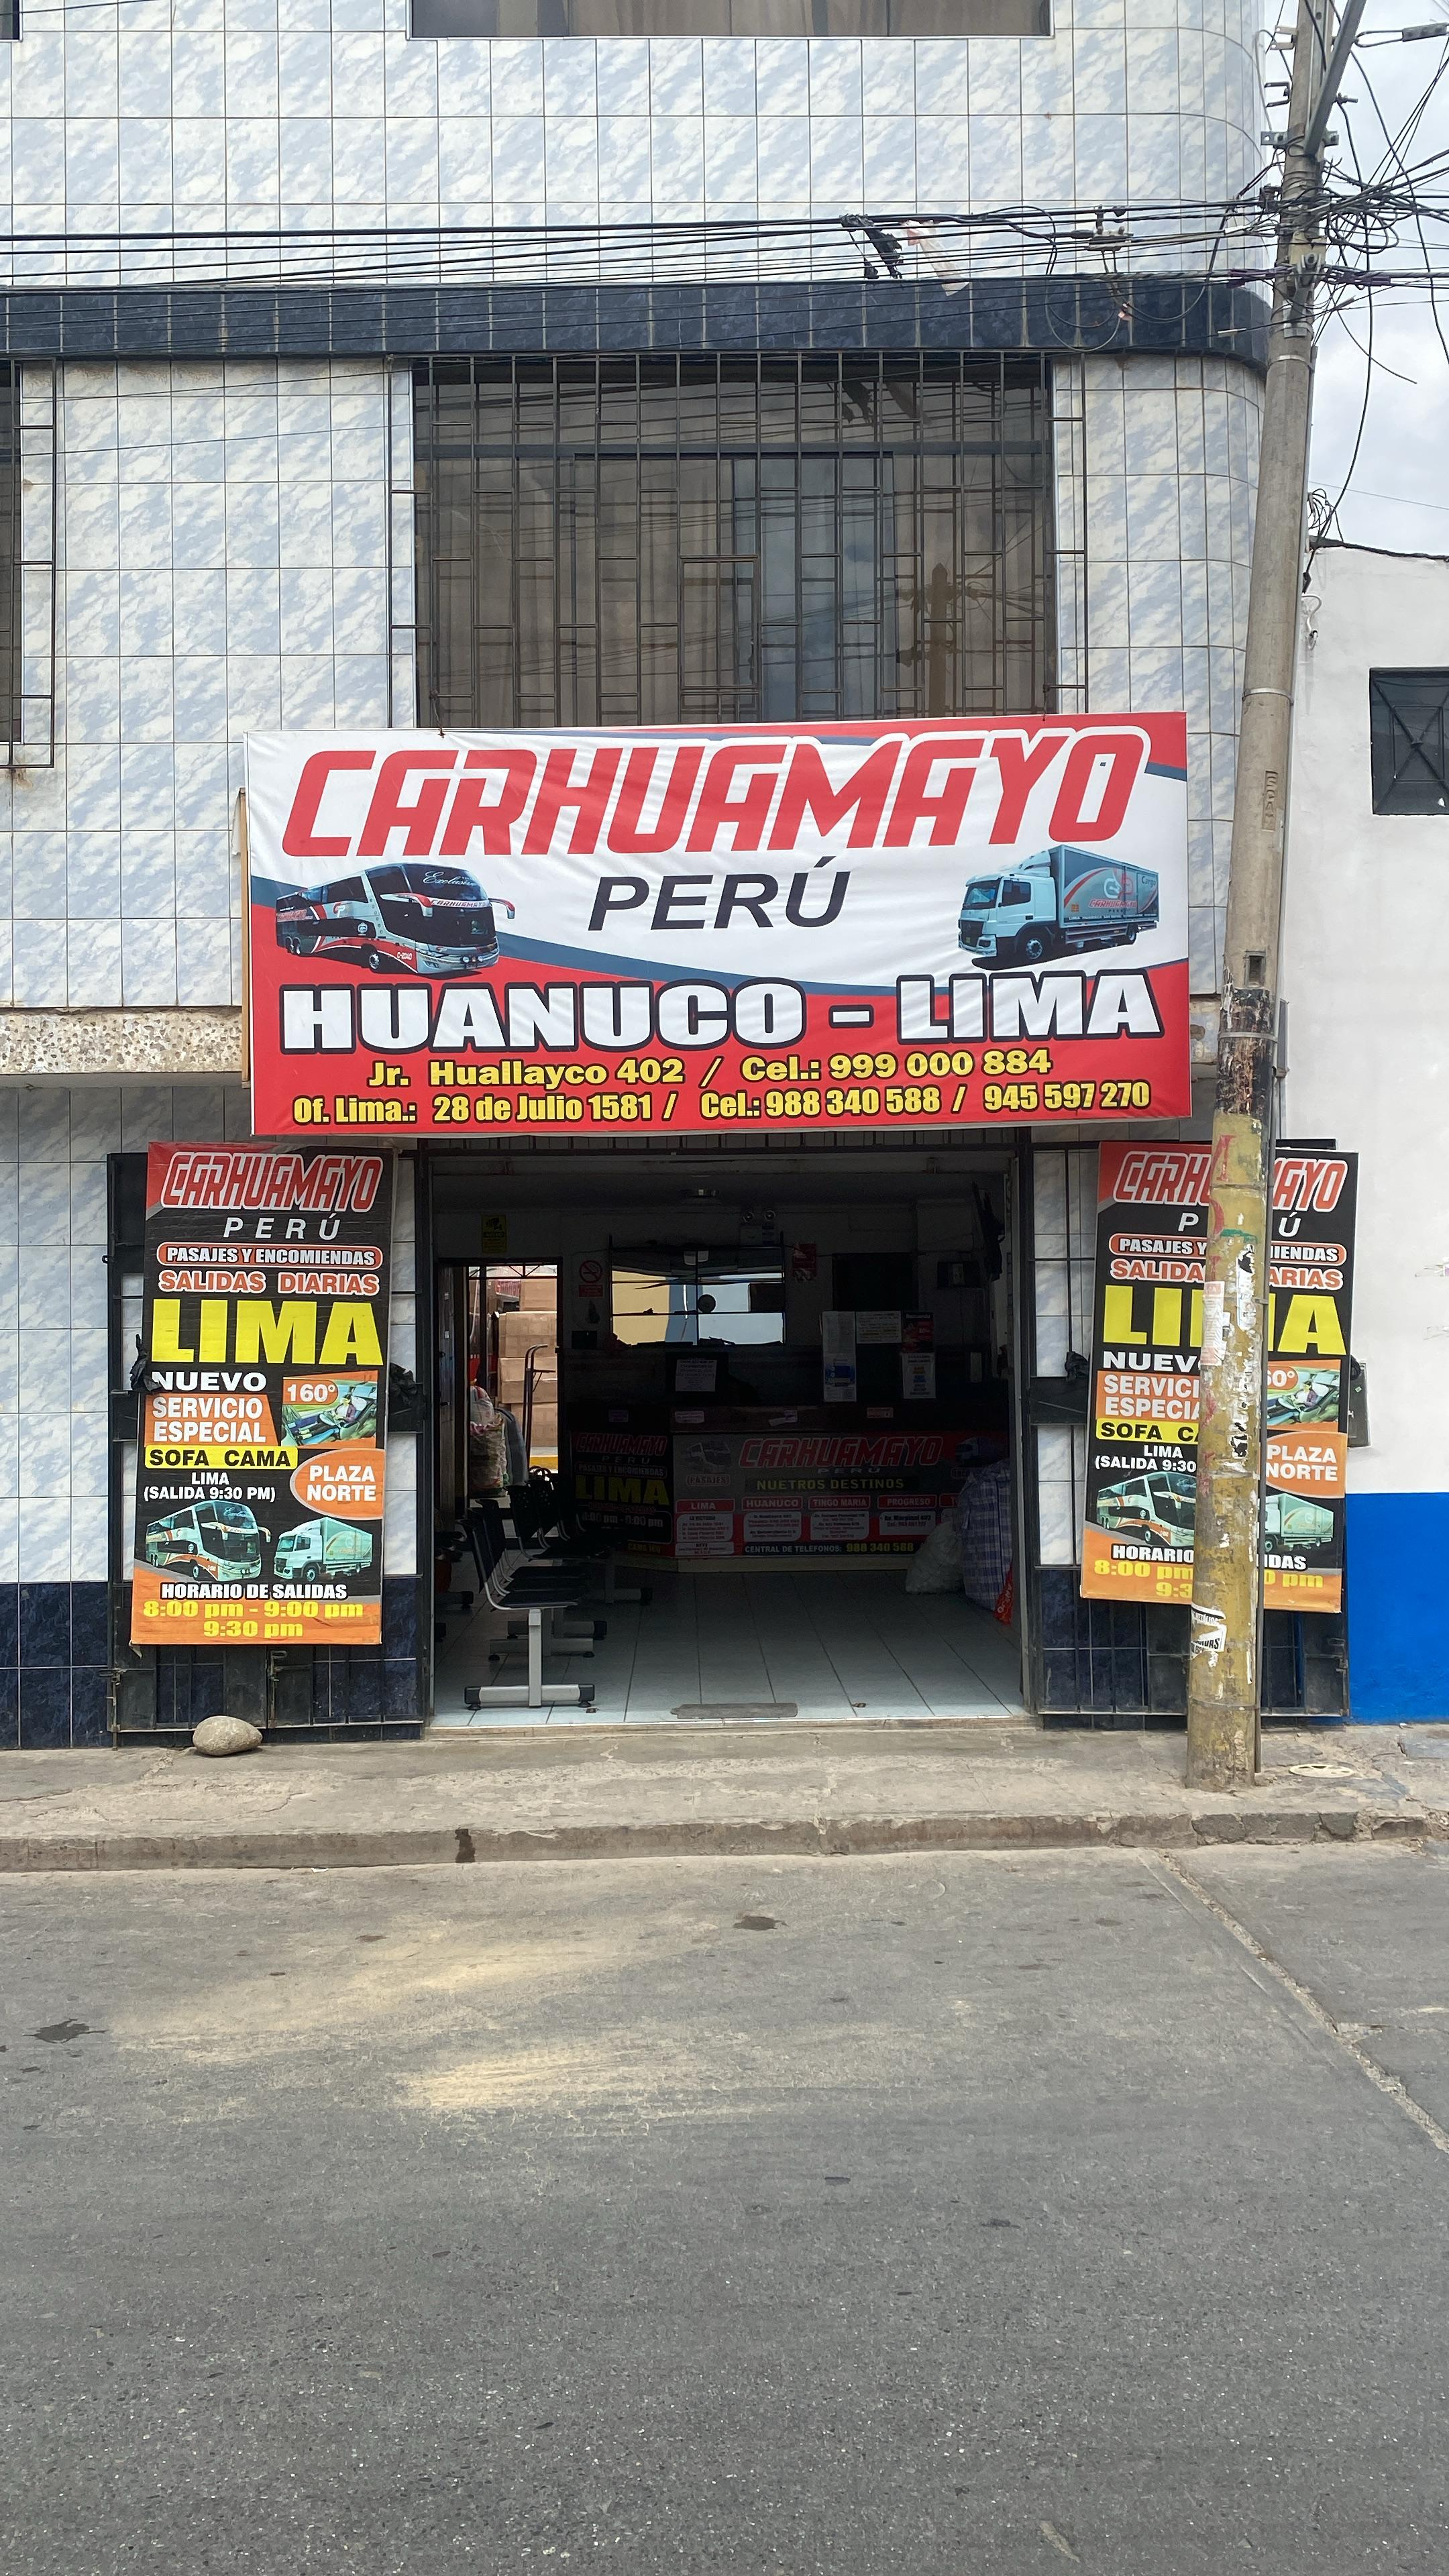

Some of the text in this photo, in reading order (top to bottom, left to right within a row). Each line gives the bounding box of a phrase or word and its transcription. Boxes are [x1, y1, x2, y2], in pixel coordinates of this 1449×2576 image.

[282, 733, 1144, 857] CARHUAMAYO
[1142, 875, 1156, 887] Cargo
[588, 855, 851, 931] PERÚ
[282, 981, 804, 1051] HUANUCO
[898, 972, 1163, 1042] LIMA
[368, 1060, 410, 1086] Jr.
[429, 1059, 607, 1089] Huallayco
[616, 1057, 684, 1083] 402
[742, 1055, 819, 1081] Cel.:
[829, 1053, 896, 1078] 999
[906, 1052, 973, 1077] 000
[983, 1049, 1052, 1075] 884
[294, 1097, 329, 1123] Of.
[433, 1096, 470, 1121] 28
[476, 1095, 506, 1120] de
[517, 1095, 582, 1121] Julio
[588, 1095, 652, 1120] 1581
[701, 1090, 759, 1118] Cel.:
[766, 1089, 820, 1116] 988
[826, 1088, 879, 1115] 340
[885, 1087, 940, 1114] 588
[983, 1084, 1037, 1111] 945
[1044, 1082, 1096, 1110] 597
[1101, 1080, 1150, 1109] 270
[160, 1152, 383, 1212] CARHUAMAYO
[1114, 1151, 1348, 1212] CARHAYO
[223, 1213, 341, 1240] PERÚ
[1178, 1212, 1301, 1237] PÚ
[167, 1247, 374, 1266] PASAJES Y ENCOMIENDAS
[1120, 1238, 1193, 1254] PASAJES
[1197, 1242, 1207, 1255] Y
[159, 1270, 380, 1295] SALIDAS DIARIAS
[1110, 1258, 1343, 1291] SALIDA ARIAS
[152, 1299, 384, 1365] LIMA
[1104, 1351, 1201, 1373] NUEV
[152, 1371, 266, 1391] NUEVO
[1104, 1374, 1199, 1399] SERVICI
[287, 1383, 335, 1402] 160°
[152, 1397, 263, 1419] SERVICIO
[154, 1421, 266, 1443] ESPECIAL
[1101, 1422, 1162, 1440] SOFA
[149, 1449, 290, 1467] SOFA CAMA
[739, 1436, 944, 1469] CARHUAMAYO
[1144, 1444, 1183, 1458] LIMA
[1267, 1444, 1337, 1464] PLAZA
[309, 1465, 375, 1482] PLAZA
[1095, 1455, 1196, 1472] (SALIDA 9:30
[1265, 1463, 1338, 1481] NORTE
[191, 1472, 229, 1485] LIMA
[757, 1478, 905, 1491] NUETROS DESTINOS
[144, 1486, 276, 1502] (SALIDA 9:30 PM)
[307, 1485, 376, 1501] NORTE
[574, 1475, 669, 1505] LIMA
[690, 1497, 931, 1510] LIMA HUANUCO TINGO MARIA PROGRESO
[745, 1545, 782, 1554] CENTRAL
[782, 1545, 793, 1553] DE
[870, 1542, 890, 1552] 340
[1113, 1545, 1193, 1563] HORARIO
[1094, 1560, 1150, 1578] 8:00
[1157, 1566, 1193, 1580] pm
[1282, 1573, 1323, 1588] pm
[161, 1583, 347, 1599] HORARIO DE SALIDAS
[143, 1600, 199, 1618] 8:00
[205, 1603, 243, 1618] pm
[264, 1601, 319, 1618] 9:00
[324, 1603, 363, 1618] pm
[203, 1620, 303, 1638] 9:30 pm
